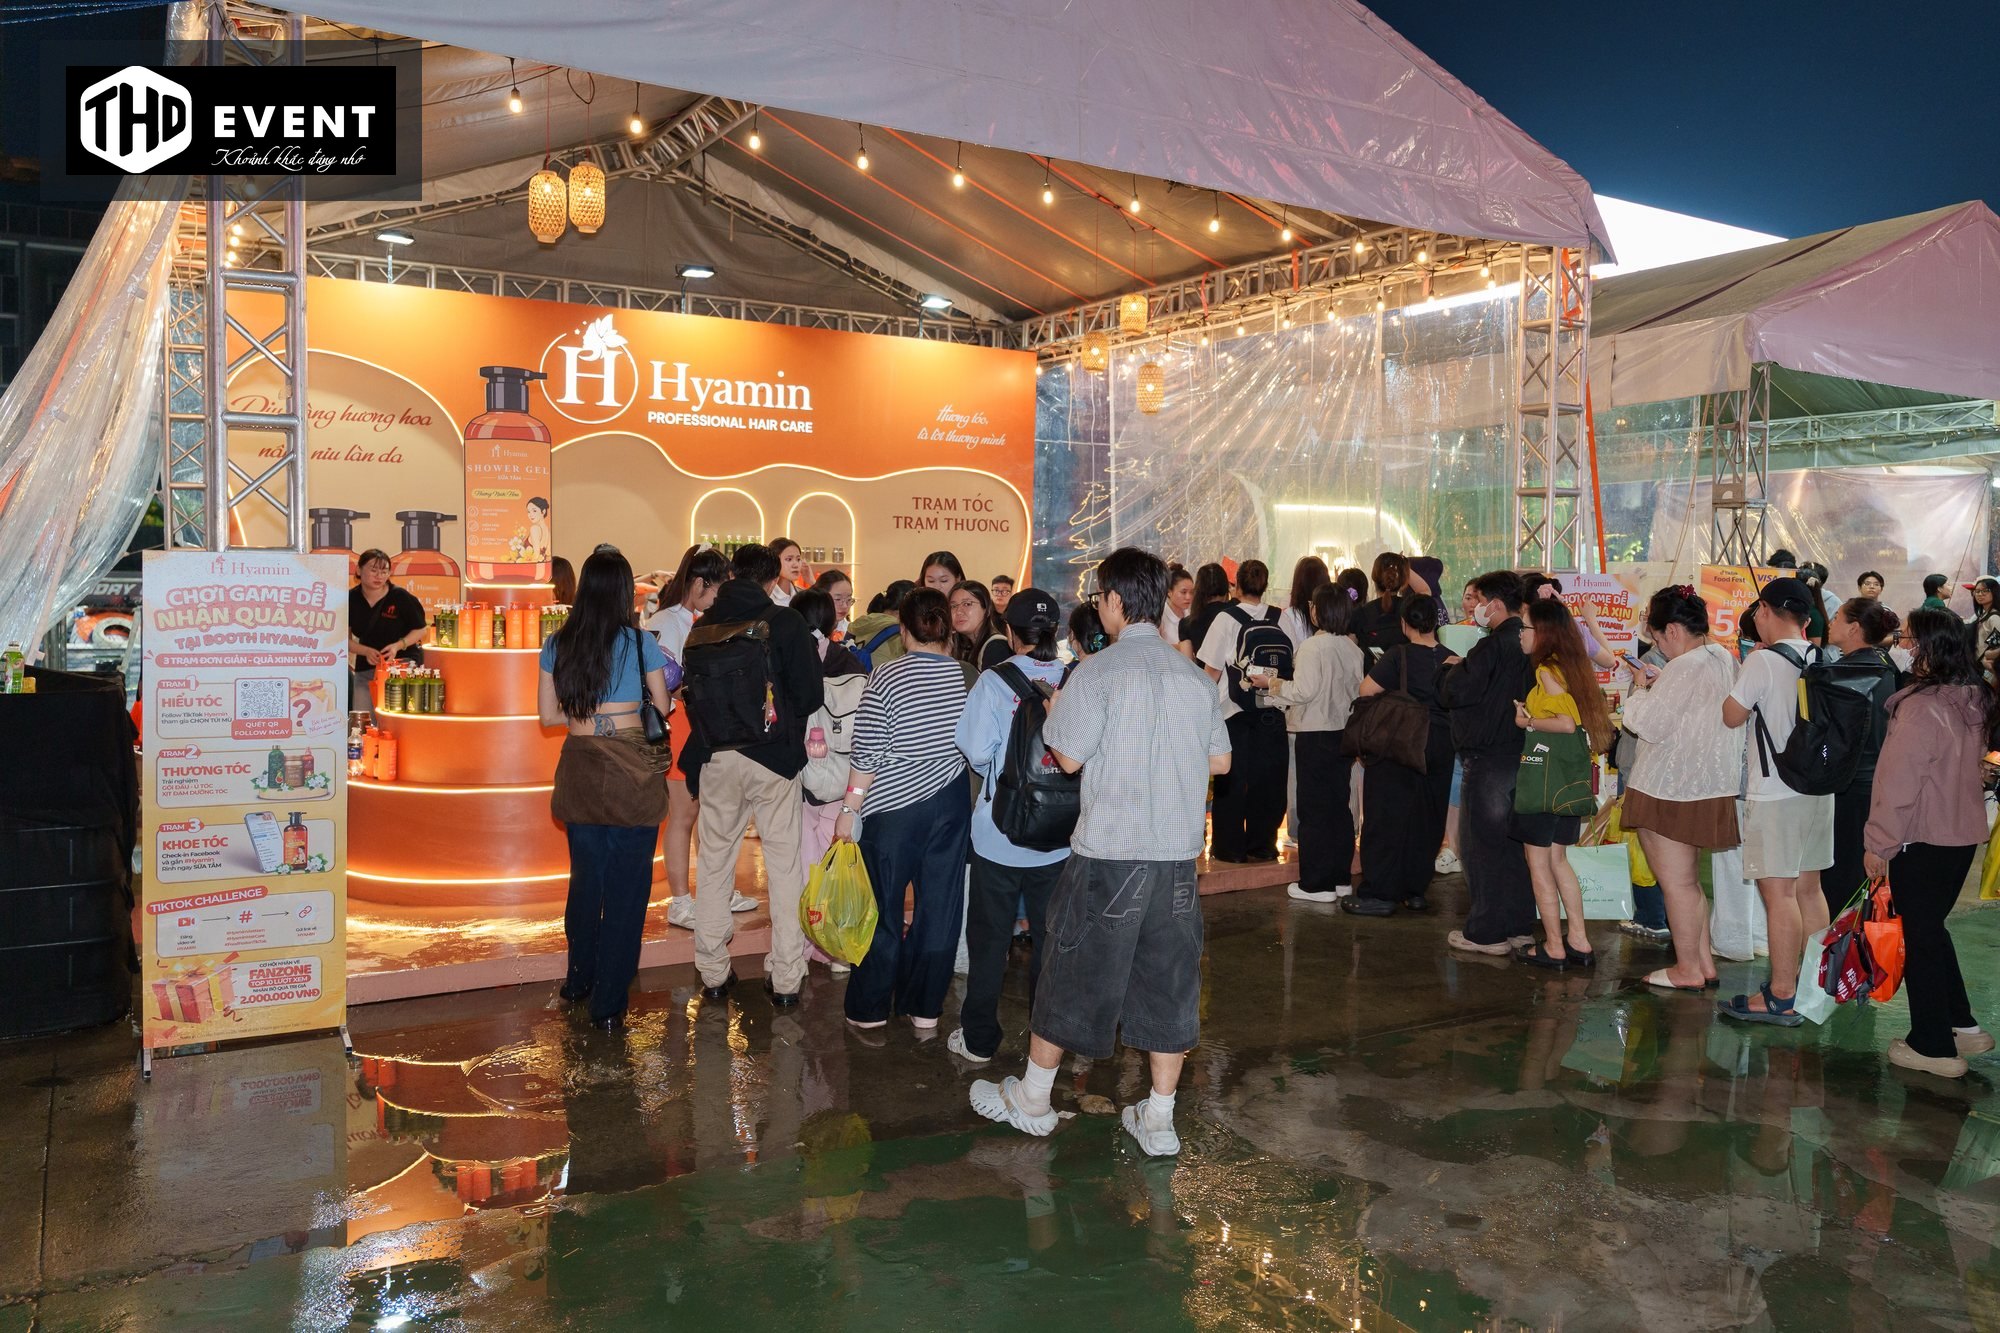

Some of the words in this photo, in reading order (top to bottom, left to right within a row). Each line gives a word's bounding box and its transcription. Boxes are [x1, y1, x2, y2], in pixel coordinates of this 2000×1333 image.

[648, 360, 813, 412] Hyamin
[340, 404, 395, 432] hương
[399, 407, 432, 426] hoa
[647, 411, 746, 430] PROFESSIONAL
[749, 418, 778, 432] HAIR
[780, 420, 813, 433] CARE
[936, 404, 970, 428] Hương
[917, 427, 929, 440] là
[945, 430, 979, 450] thương
[980, 433, 1007, 446] mình
[311, 447, 340, 461] niu
[344, 444, 373, 462] làn
[378, 447, 404, 464] da
[466, 464, 520, 473] SHOWER
[525, 465, 549, 475] GEL
[912, 497, 957, 514] TRẠM
[962, 493, 993, 513] TÓC
[892, 516, 938, 534] TRẠM
[944, 517, 1009, 533] THƯƠNG
[232, 562, 290, 577] Hyamin
[1584, 580, 1612, 588] Hyamin
[1757, 574, 1778, 582] VISA
[169, 586, 225, 607] CHƠI
[230, 587, 291, 603] GAME
[296, 582, 325, 608] DỄ
[1562, 593, 1582, 604] HƠI
[1613, 591, 1629, 606] DỄ
[1733, 589, 1746, 598] ƯU
[157, 603, 230, 630] NHẬN
[235, 603, 288, 628] QUÀ
[292, 609, 334, 633] XỊN
[1611, 608, 1632, 621] XỊN
[175, 635, 201, 651] TẠI
[203, 632, 257, 646] BOOTH
[260, 632, 319, 649] HYAMIN
[163, 657, 170, 665] 3
[170, 657, 199, 666] TRẠM
[199, 656, 223, 665] ĐƠN
[224, 654, 248, 664] GIẢN
[253, 654, 274, 664] QUÀ
[275, 656, 297, 664] XINH
[297, 653, 310, 664] VỀ
[311, 656, 329, 664] TAY
[187, 675, 196, 691] 1
[162, 692, 197, 708] HIỂU
[198, 694, 222, 707] TÓC
[269, 728, 289, 736] NGAY
[186, 744, 198, 759] 2
[162, 764, 223, 777] THƯƠNG
[224, 762, 251, 774] TÓC
[187, 817, 200, 833] 3
[202, 835, 229, 848] TÓC
[184, 857, 214, 865] #Hyamin
[177, 865, 192, 873] ngay
[151, 900, 192, 914] TIKTOK
[195, 888, 262, 907] CHALLENGE
[250, 964, 312, 979] FANZONE
[274, 977, 291, 985] LƯỢT
[292, 976, 308, 984] XEM
[240, 990, 295, 1005] 2.000.000
[296, 988, 320, 999] VNĐ
